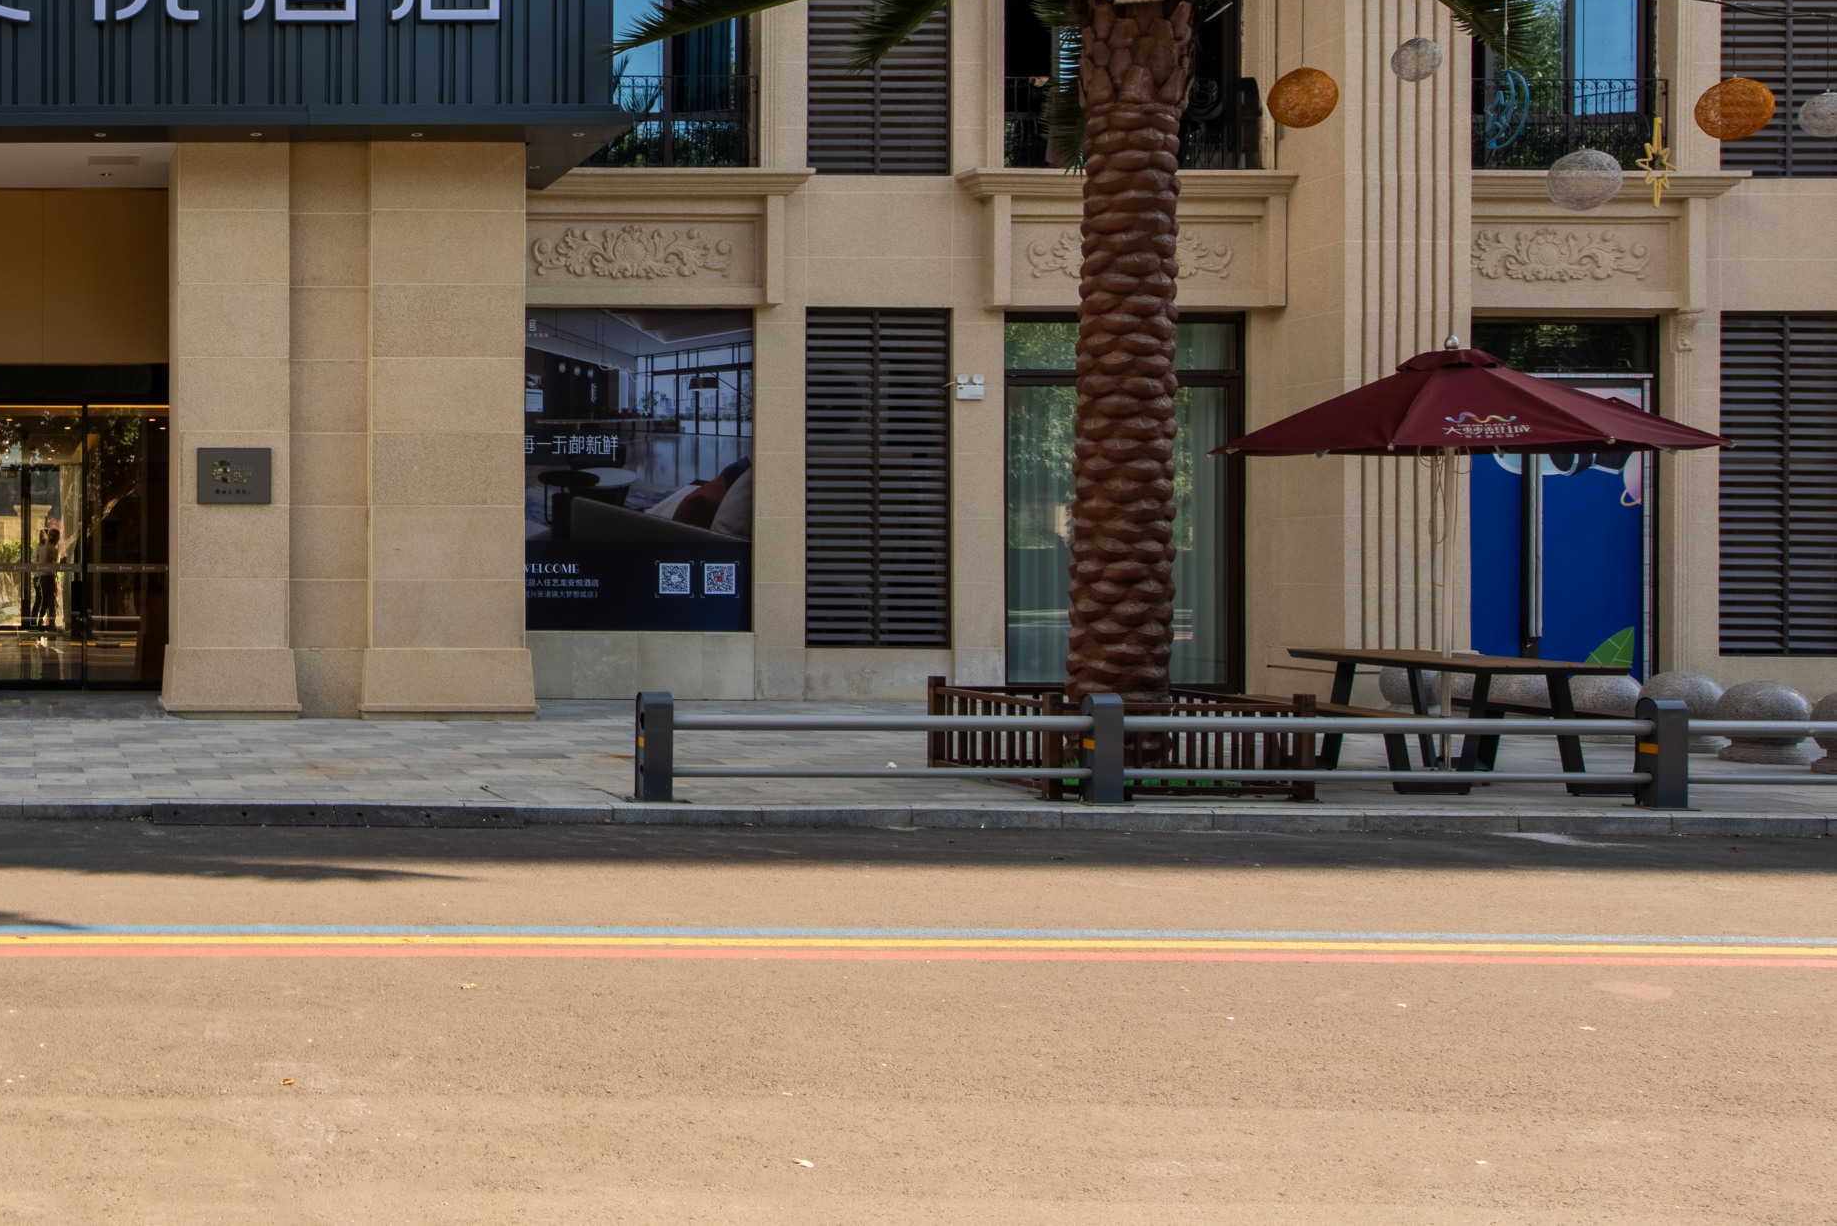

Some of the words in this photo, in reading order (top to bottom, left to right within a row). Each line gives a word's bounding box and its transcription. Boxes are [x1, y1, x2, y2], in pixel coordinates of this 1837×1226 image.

[525, 578, 599, 587] 迎入住艺龙安悦酒店
